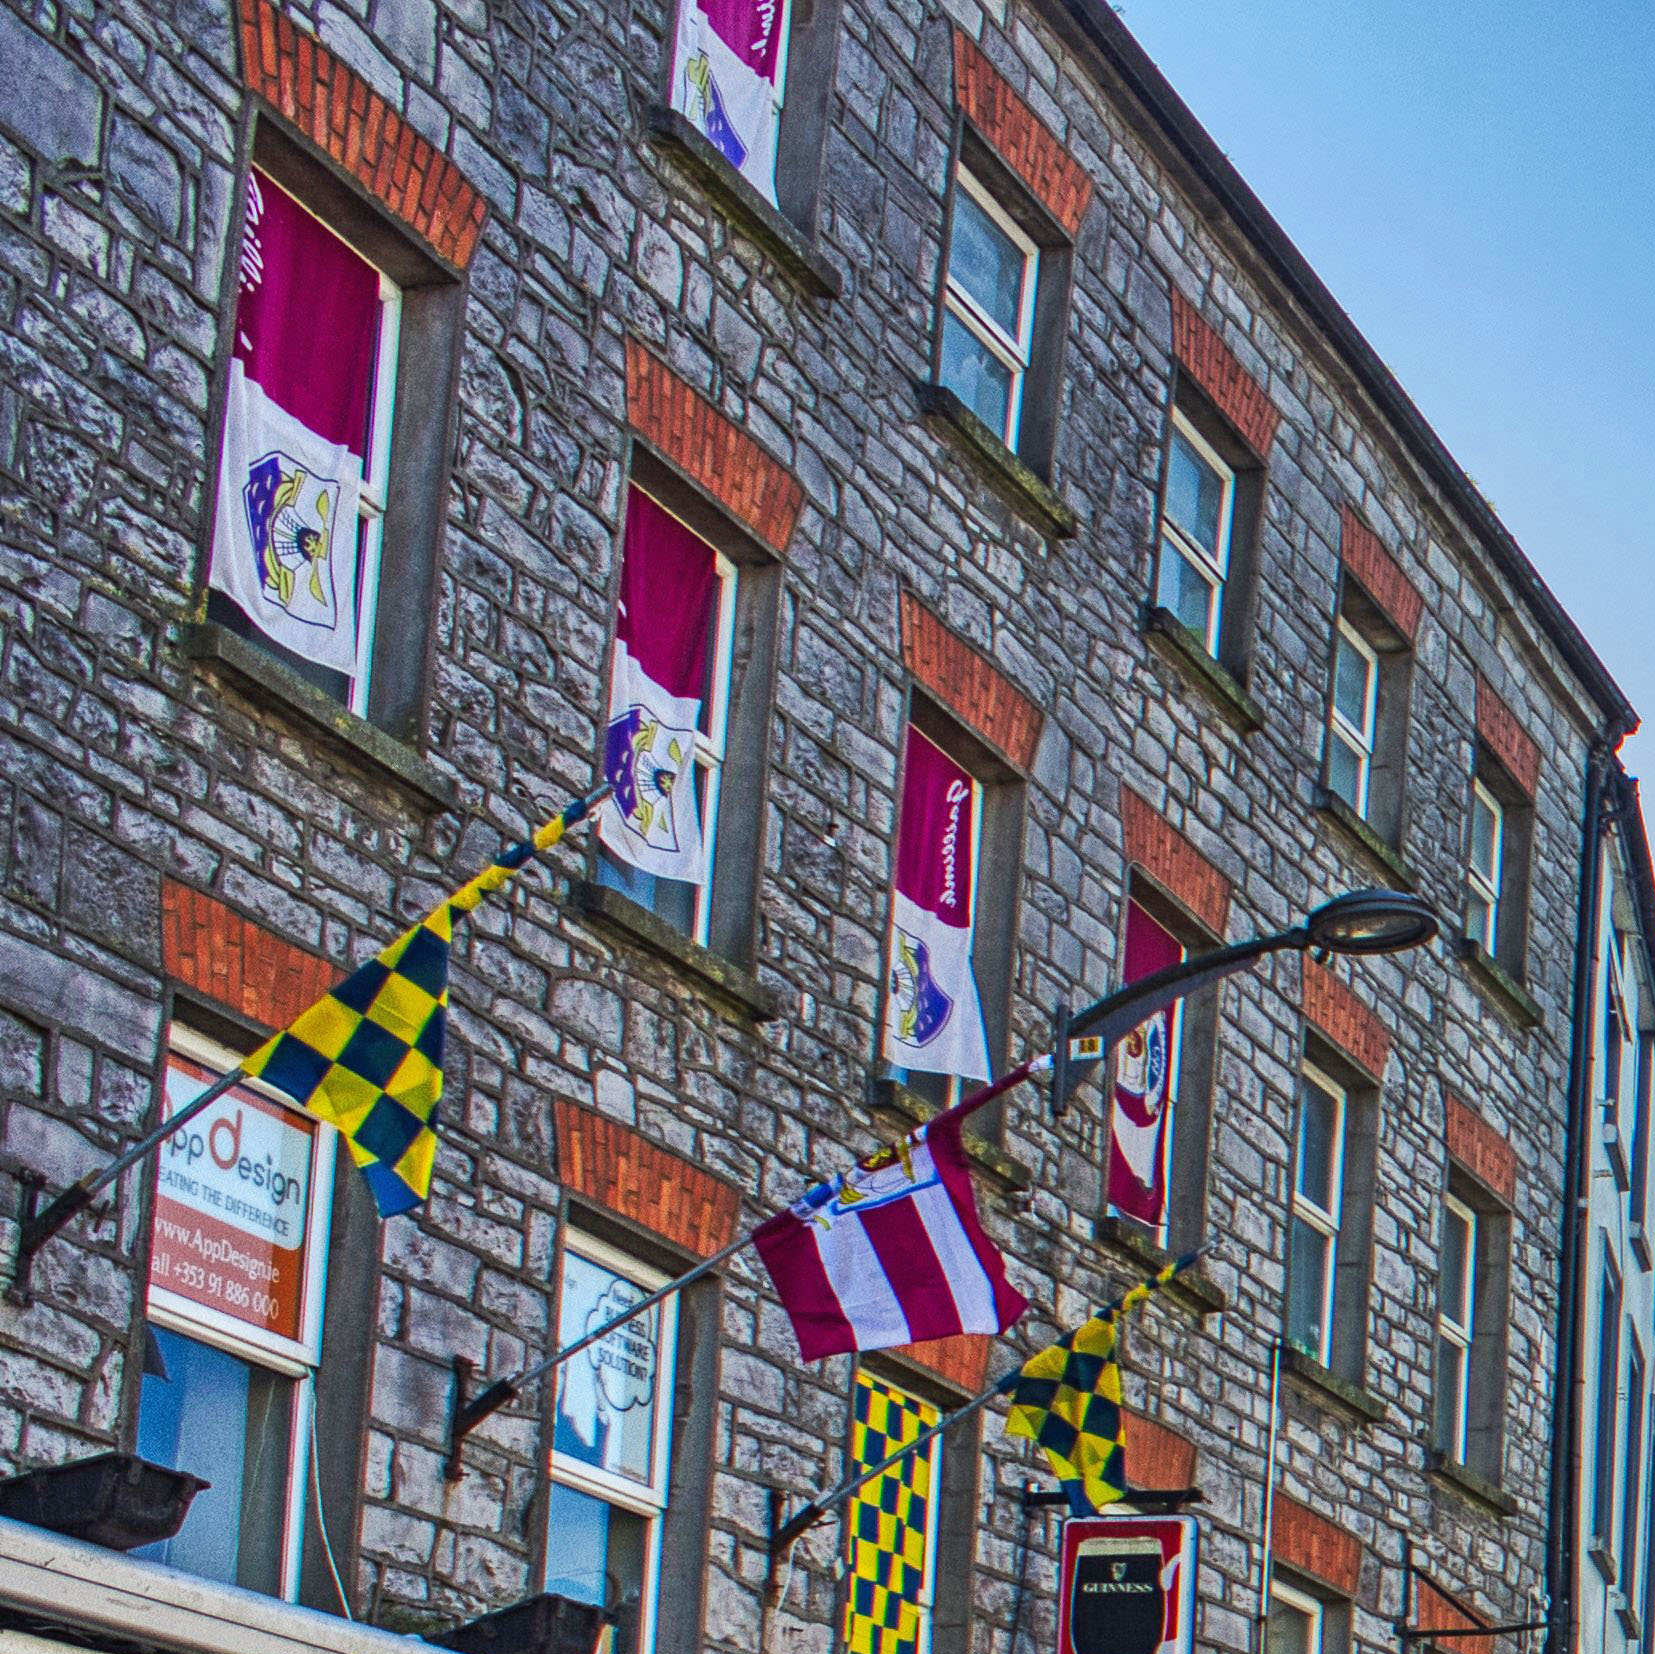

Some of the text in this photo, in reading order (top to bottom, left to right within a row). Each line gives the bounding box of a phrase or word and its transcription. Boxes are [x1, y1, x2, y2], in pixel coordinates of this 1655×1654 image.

[201, 1185, 223, 1207] THE
[224, 1194, 290, 1237] DIFFERENCE
[173, 1261, 205, 1291] +353
[208, 1275, 223, 1298] 91
[1083, 1582, 1153, 1593] GUINNESS
